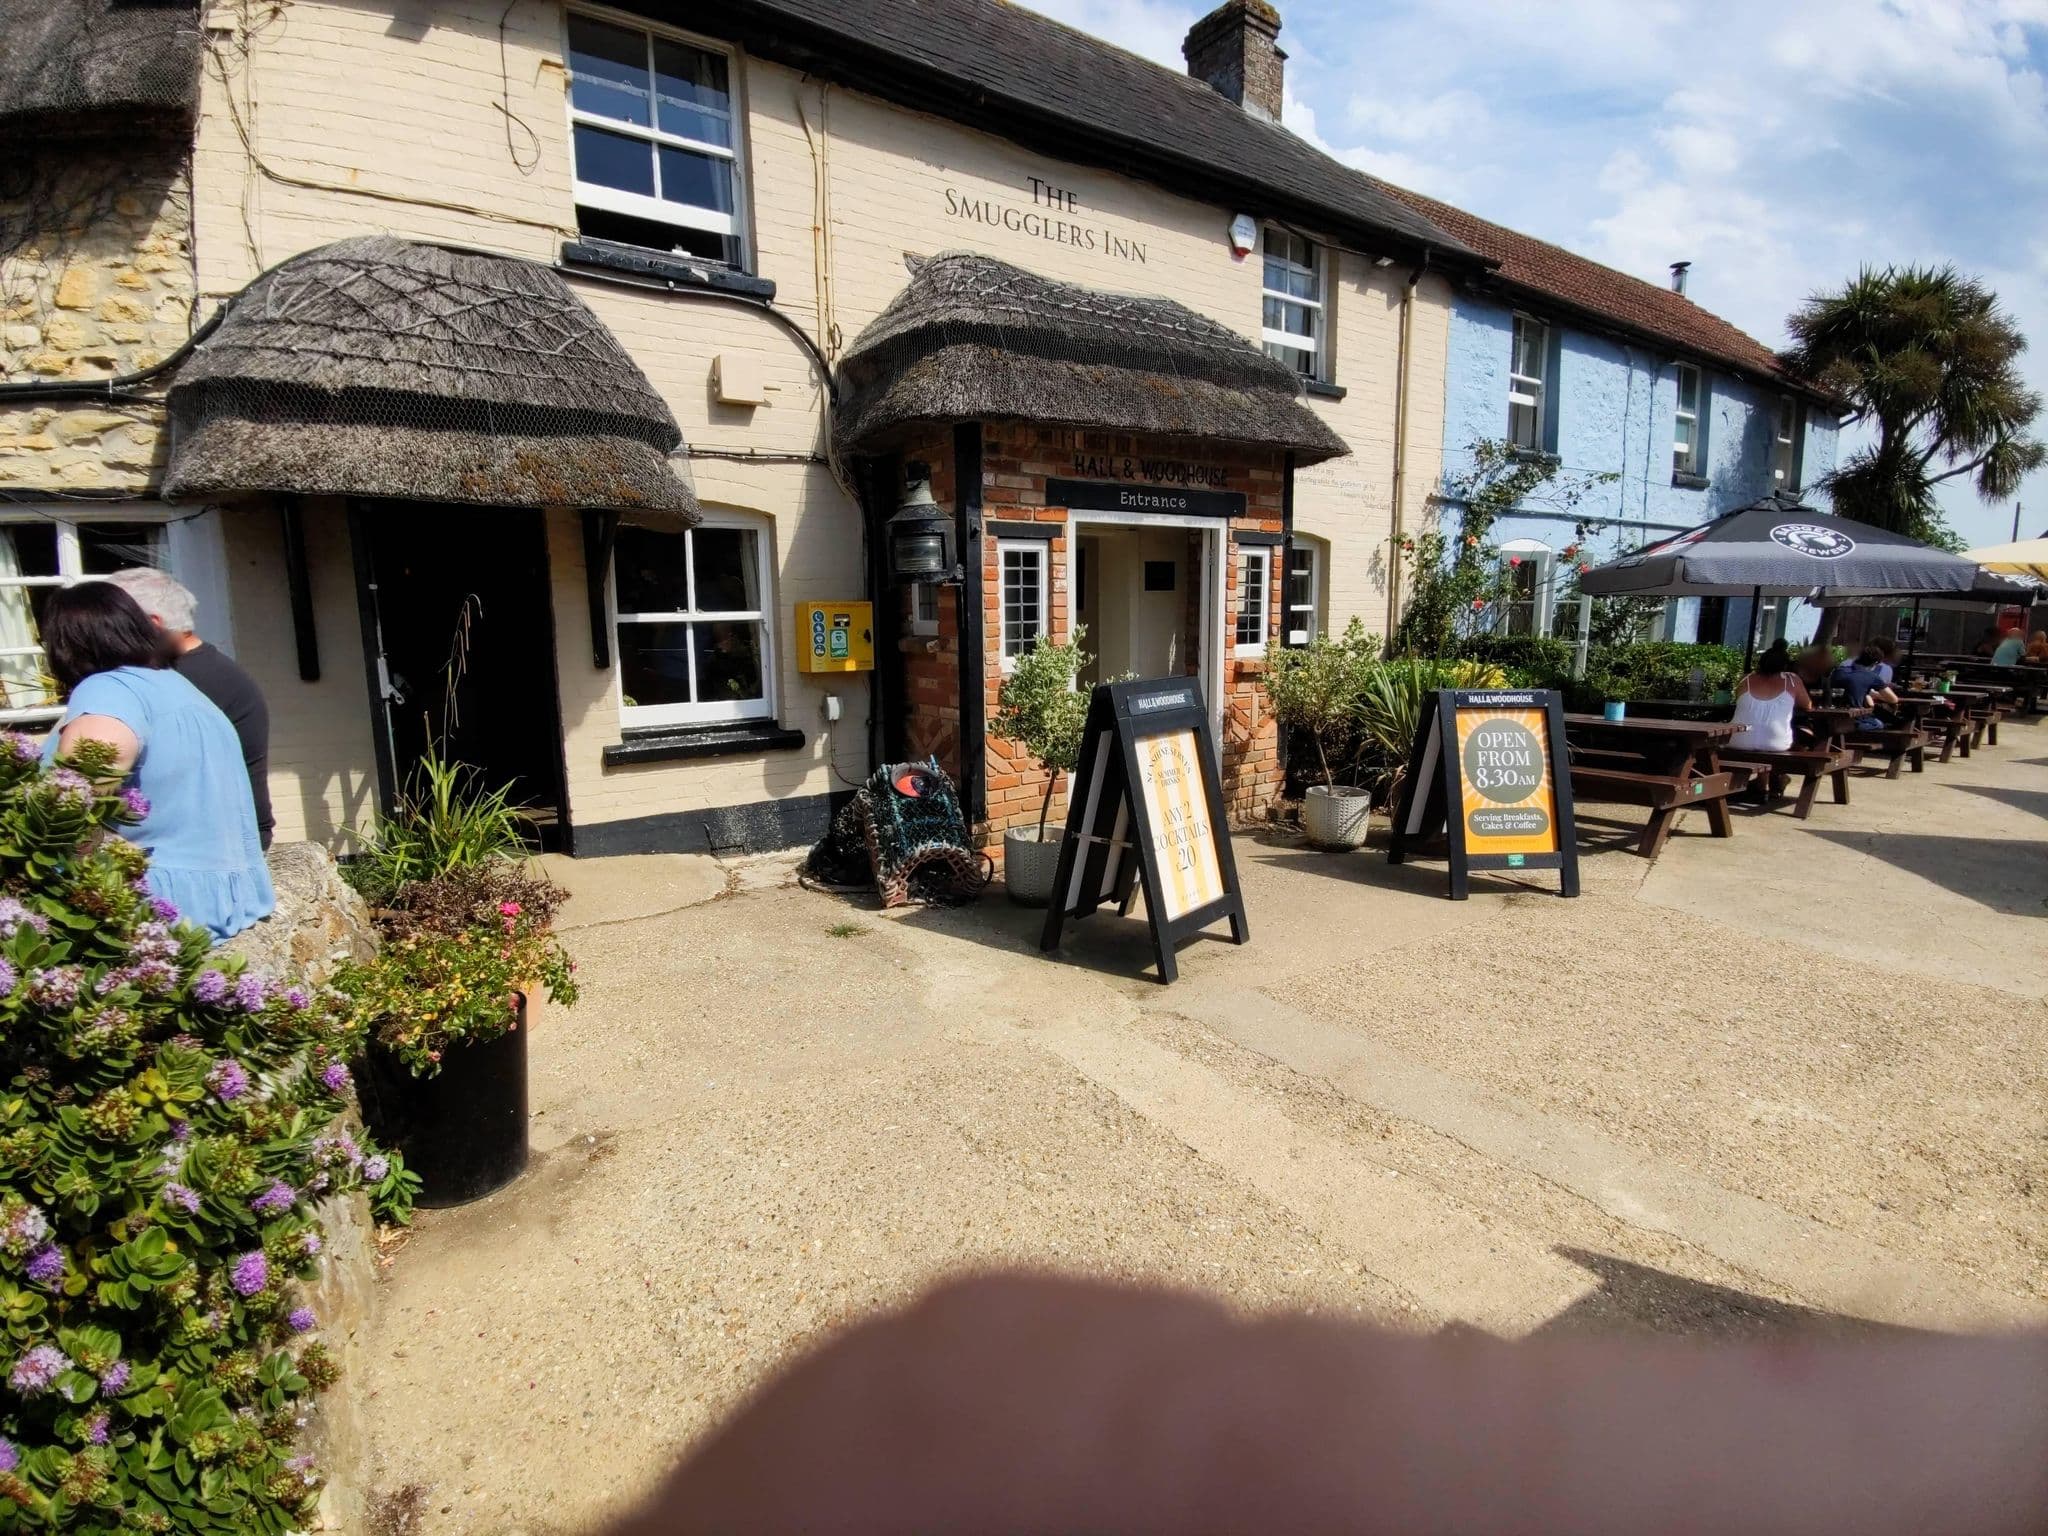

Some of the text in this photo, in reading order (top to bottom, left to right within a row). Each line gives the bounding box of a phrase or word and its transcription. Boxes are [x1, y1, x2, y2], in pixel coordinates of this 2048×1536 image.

[1027, 176, 1078, 215] THE
[945, 188, 1147, 264] SMUGGLERS INN
[1074, 454, 1228, 487] HALL & WOODHOUSE
[1120, 491, 1187, 509] Entrance
[1775, 525, 1836, 537] BADGER
[1477, 731, 1527, 748] OPEN
[1476, 750, 1532, 767] FROM
[1163, 801, 1192, 826] ANY 2
[1473, 812, 1543, 822] Serving Breakfasts,
[1481, 820, 1537, 830] Cakes & Coffee
[1154, 821, 1209, 851] COCKTAILS
